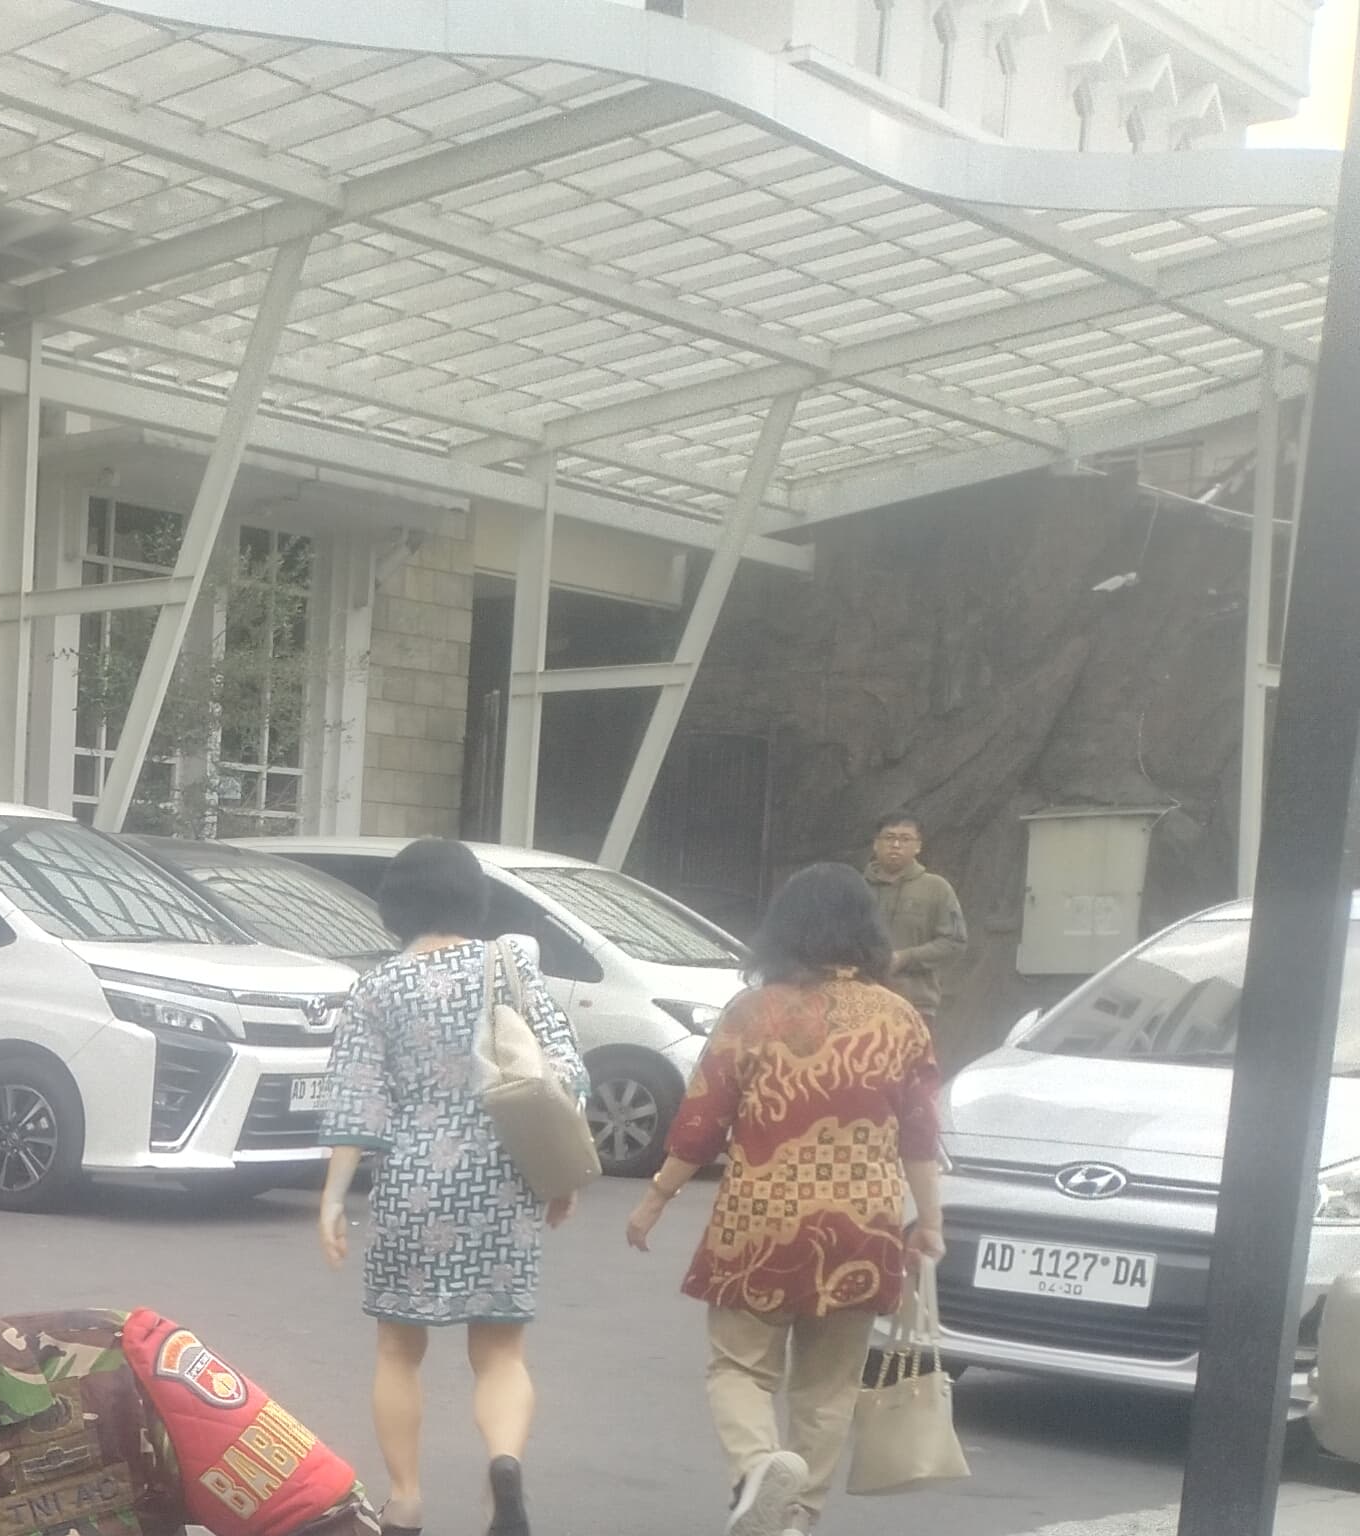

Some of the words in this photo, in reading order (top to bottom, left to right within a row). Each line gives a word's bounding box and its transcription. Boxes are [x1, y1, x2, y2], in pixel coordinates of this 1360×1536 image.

[981, 1242, 1015, 1272] AD
[1029, 1247, 1099, 1282] 1127
[1112, 1256, 1148, 1288] DA
[6, 1491, 63, 1526] TNI
